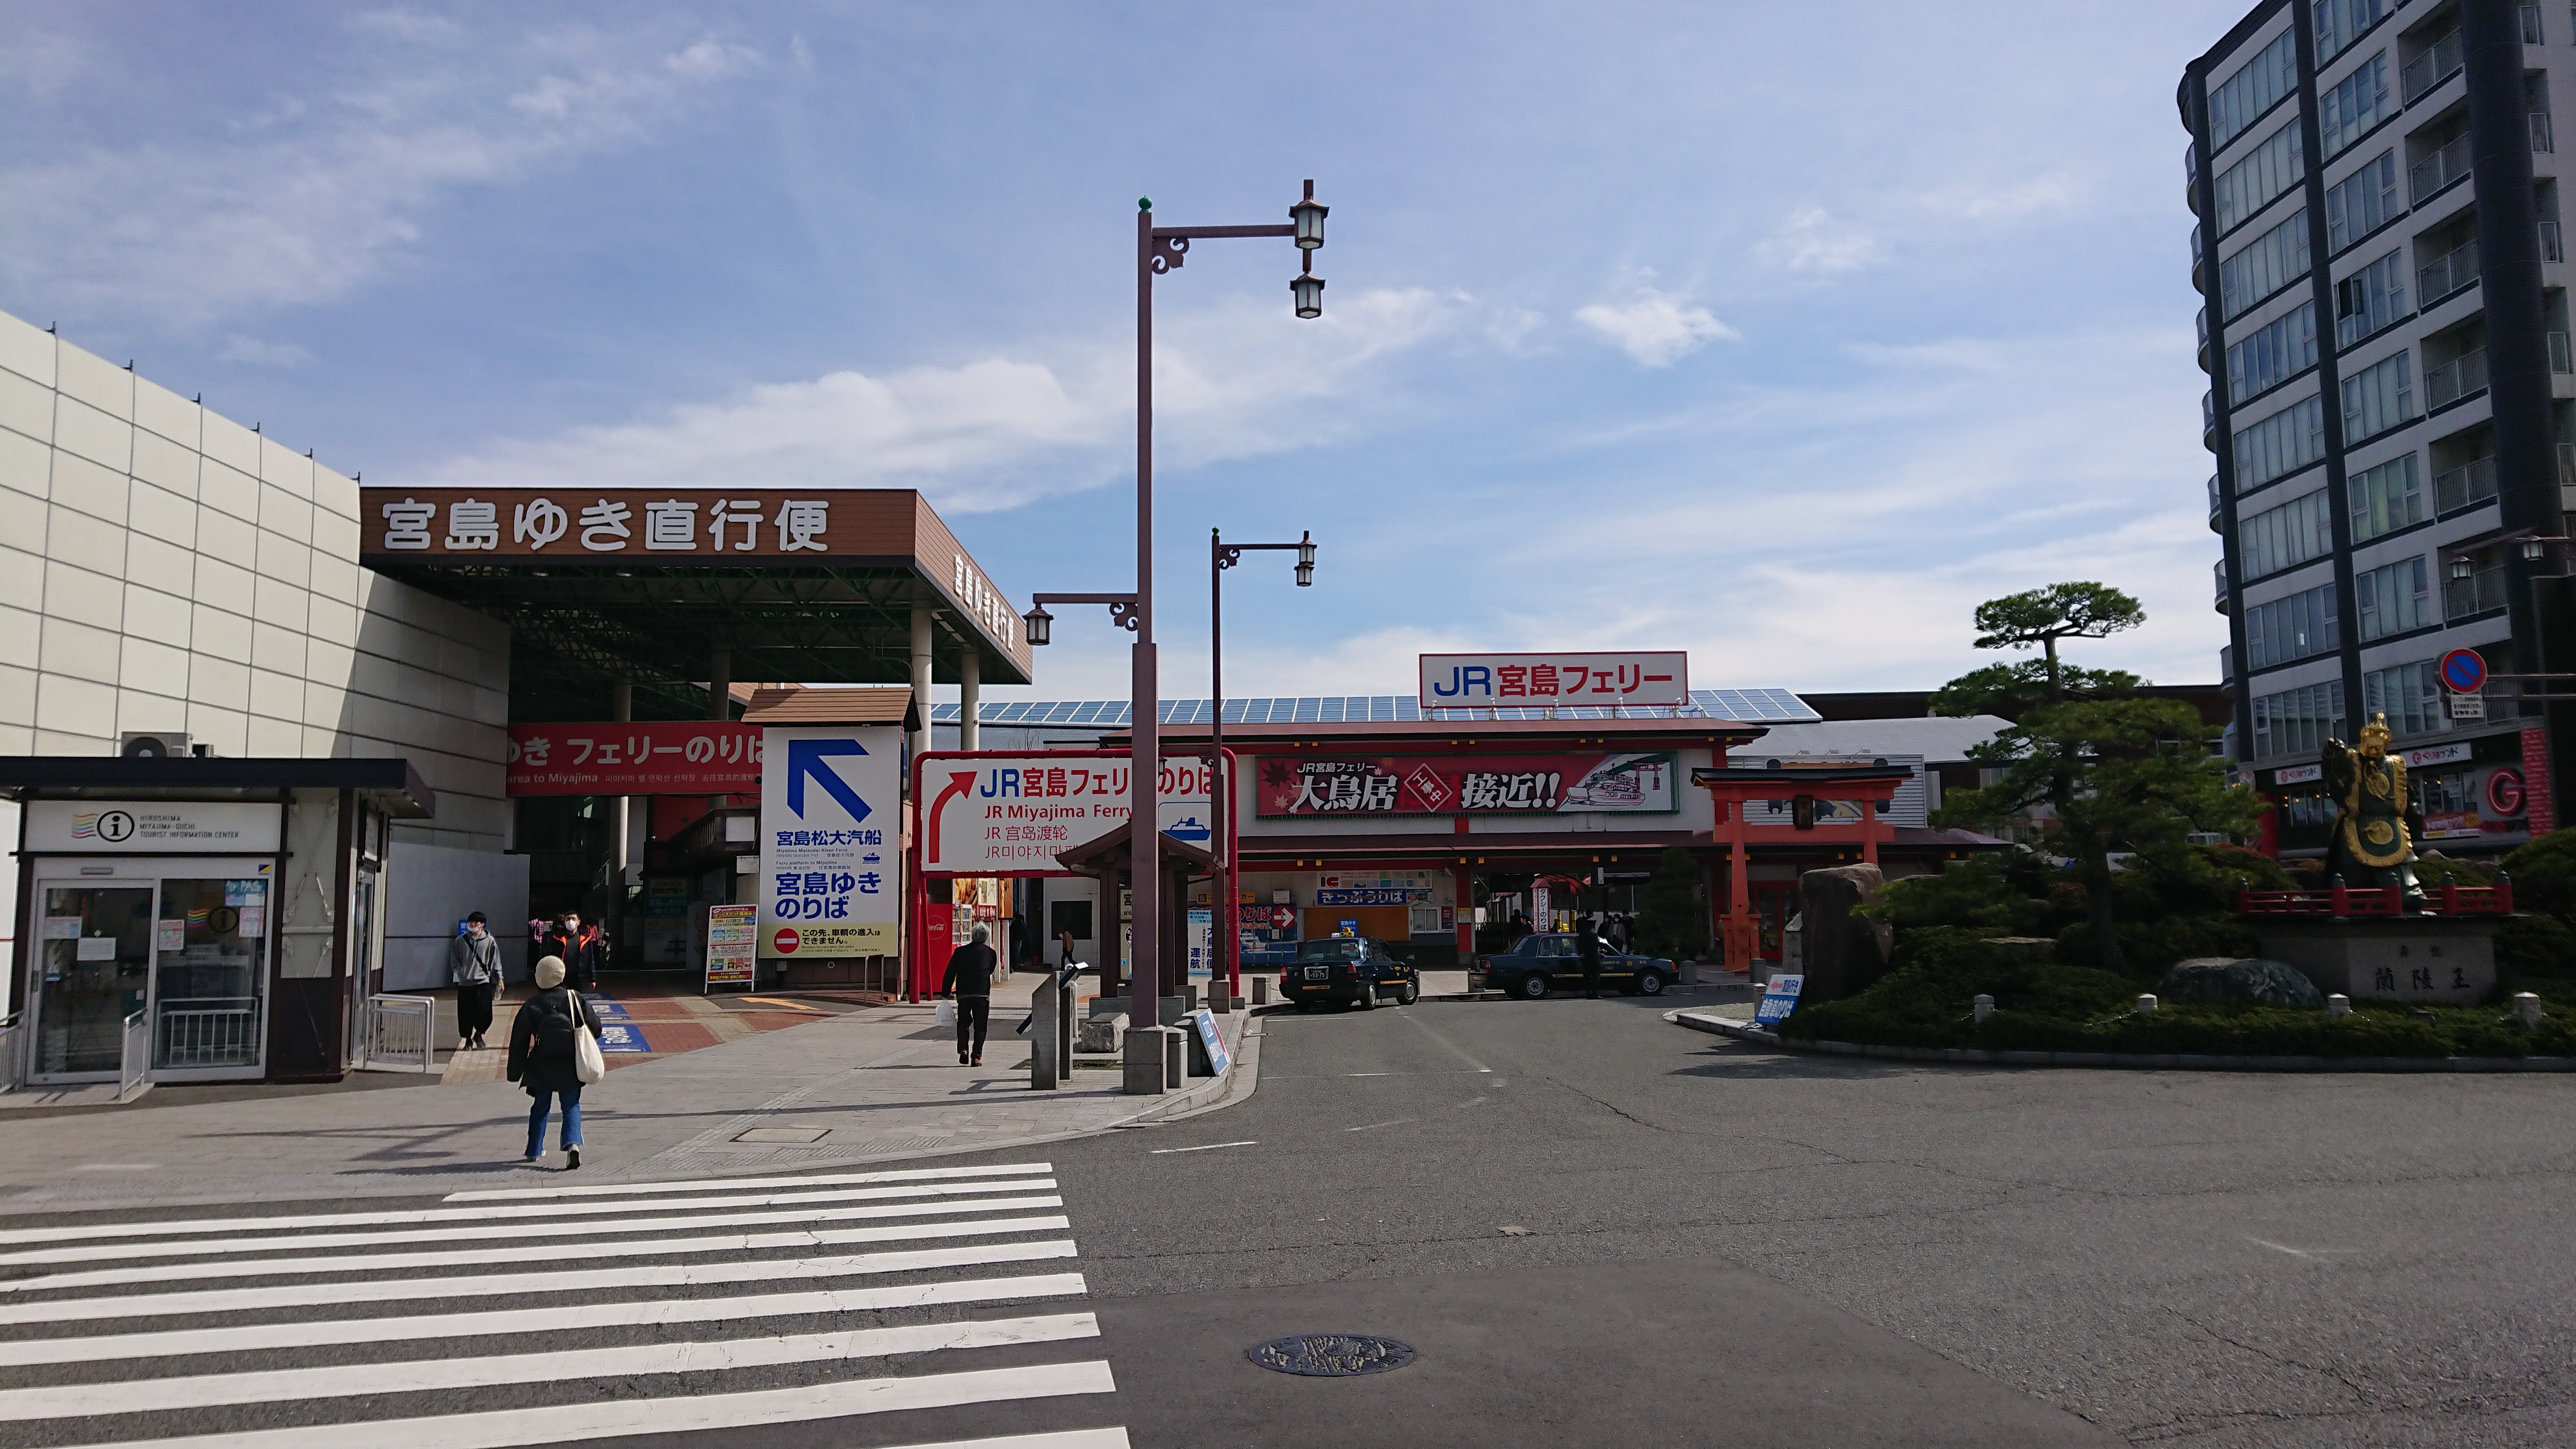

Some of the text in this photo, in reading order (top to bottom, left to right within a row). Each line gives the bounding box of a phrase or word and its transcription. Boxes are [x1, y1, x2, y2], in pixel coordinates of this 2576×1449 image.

[381, 497, 830, 552] 宮島ゆき直行便
[954, 554, 1014, 652] 宮島ゆき直行便
[1434, 664, 1672, 697] JR宮島フェリー
[534, 774, 545, 783] to
[549, 773, 598, 785] Miyajima
[1297, 762, 1376, 773] JR宮島フェリー
[1291, 774, 1398, 811] 大鳥居
[1412, 772, 1442, 802] 工事中
[2487, 767, 2523, 816] G
[984, 804, 1132, 822] JR Miyajima Ferry
[776, 829, 882, 846] 宮島松大汽船
[984, 827, 1001, 840] JR
[775, 871, 882, 896] 宮島ゆき
[775, 896, 849, 920] のりば
[1321, 890, 1403, 904] きっぷうりば
[1190, 947, 1200, 969] 運航
